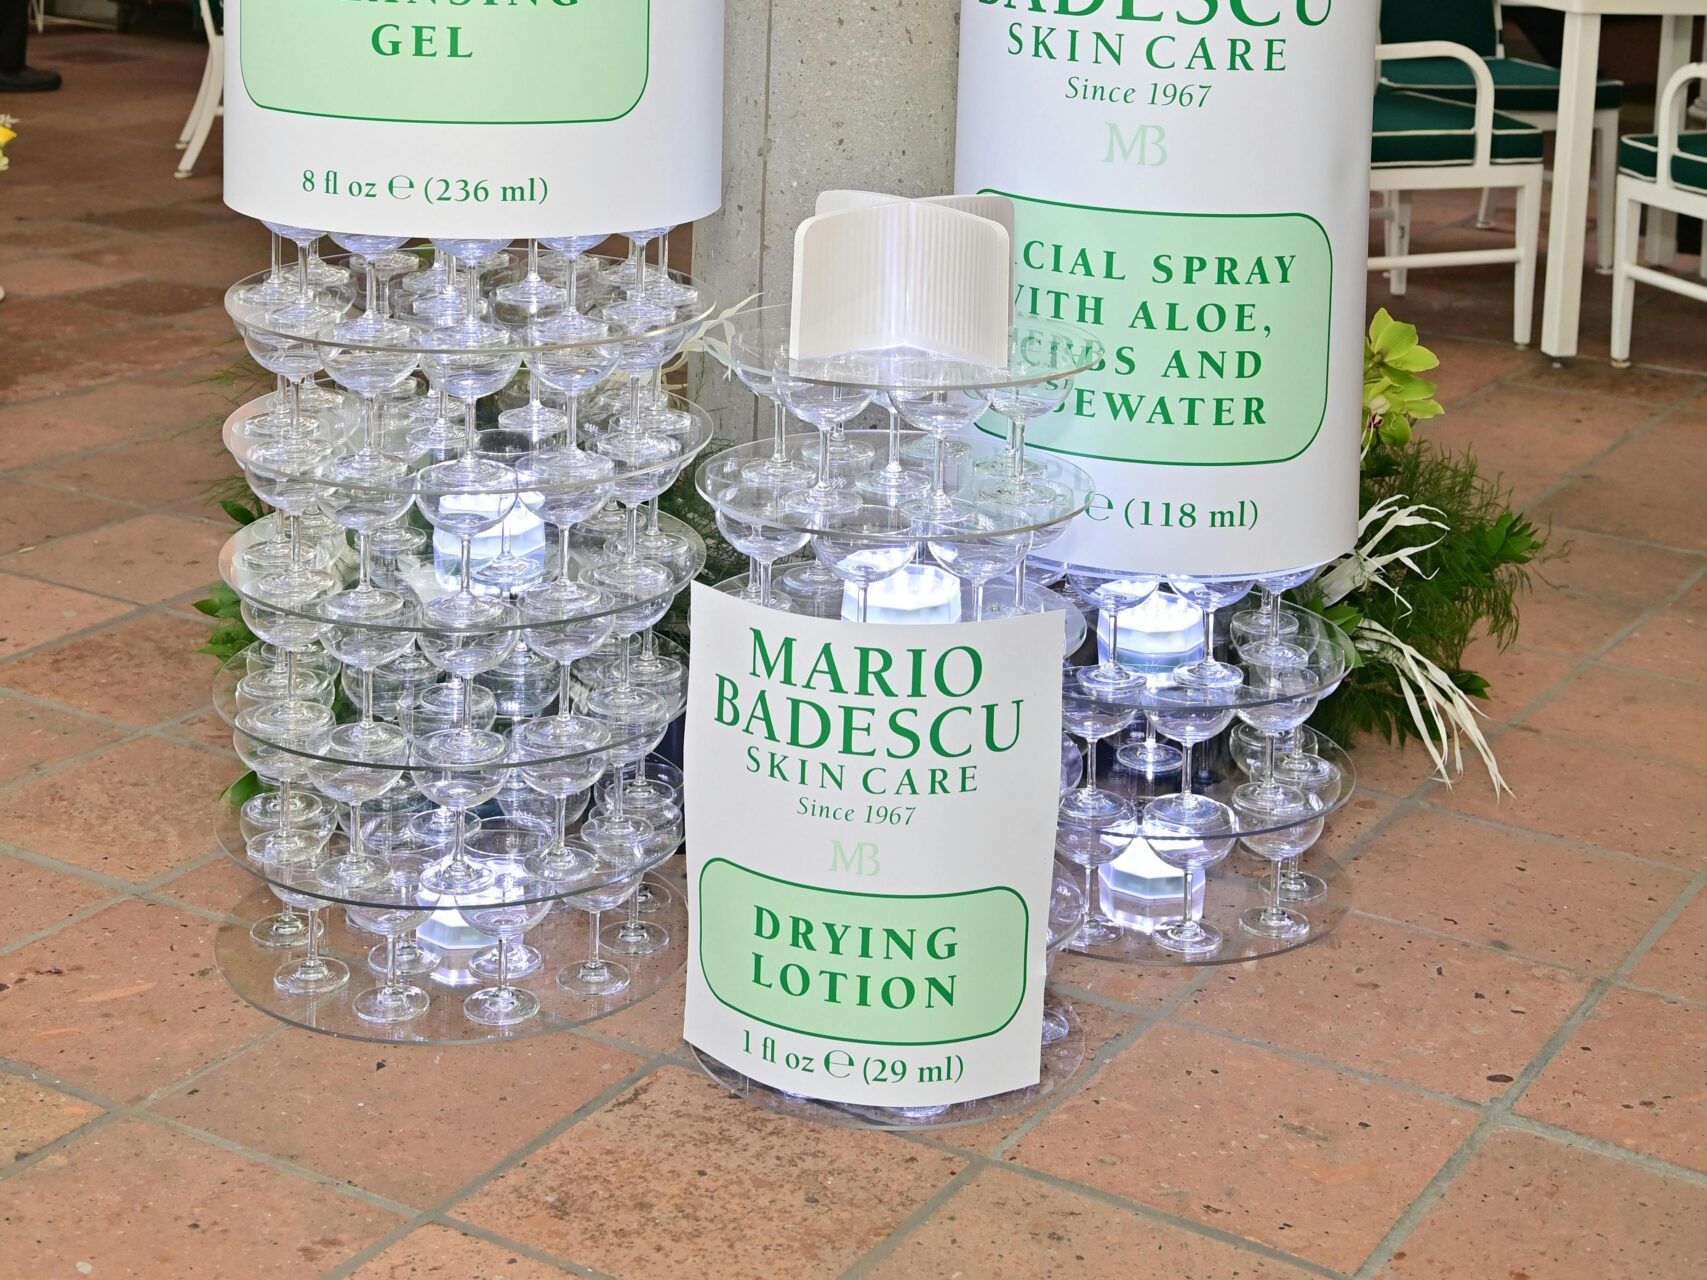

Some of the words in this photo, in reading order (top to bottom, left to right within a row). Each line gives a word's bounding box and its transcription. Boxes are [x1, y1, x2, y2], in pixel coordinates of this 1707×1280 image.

[371, 23, 474, 59] GEL
[1007, 22, 1125, 66] SKIN
[1145, 35, 1287, 72] CARE
[1065, 76, 1136, 105] Since
[1147, 81, 1212, 108] 1967
[302, 170, 316, 194] 8
[323, 170, 339, 196] fl
[348, 181, 378, 199] oz
[423, 177, 490, 205] (236
[500, 176, 549, 206] ml)
[1014, 239, 1127, 282] CIAL
[1151, 253, 1297, 287] SPRAY
[1128, 301, 1272, 339] ALOE,
[1161, 348, 1263, 381] AND
[1052, 386, 1267, 428] EWATER
[1124, 497, 1197, 530] (118
[1209, 498, 1260, 532] ml)
[749, 627, 983, 698] MARIO
[714, 673, 1024, 759] BADESCU
[746, 745, 845, 792] SKIN
[862, 765, 979, 796] CARE
[797, 796, 855, 823] Since
[865, 805, 916, 826] 1967
[753, 904, 958, 961] DRYING
[752, 951, 957, 1010] LOTION
[742, 1029, 751, 1055] 1
[761, 1036, 777, 1064] fl
[785, 1052, 815, 1074] oz
[862, 1058, 908, 1086] (29
[917, 1053, 964, 1084] ml)
